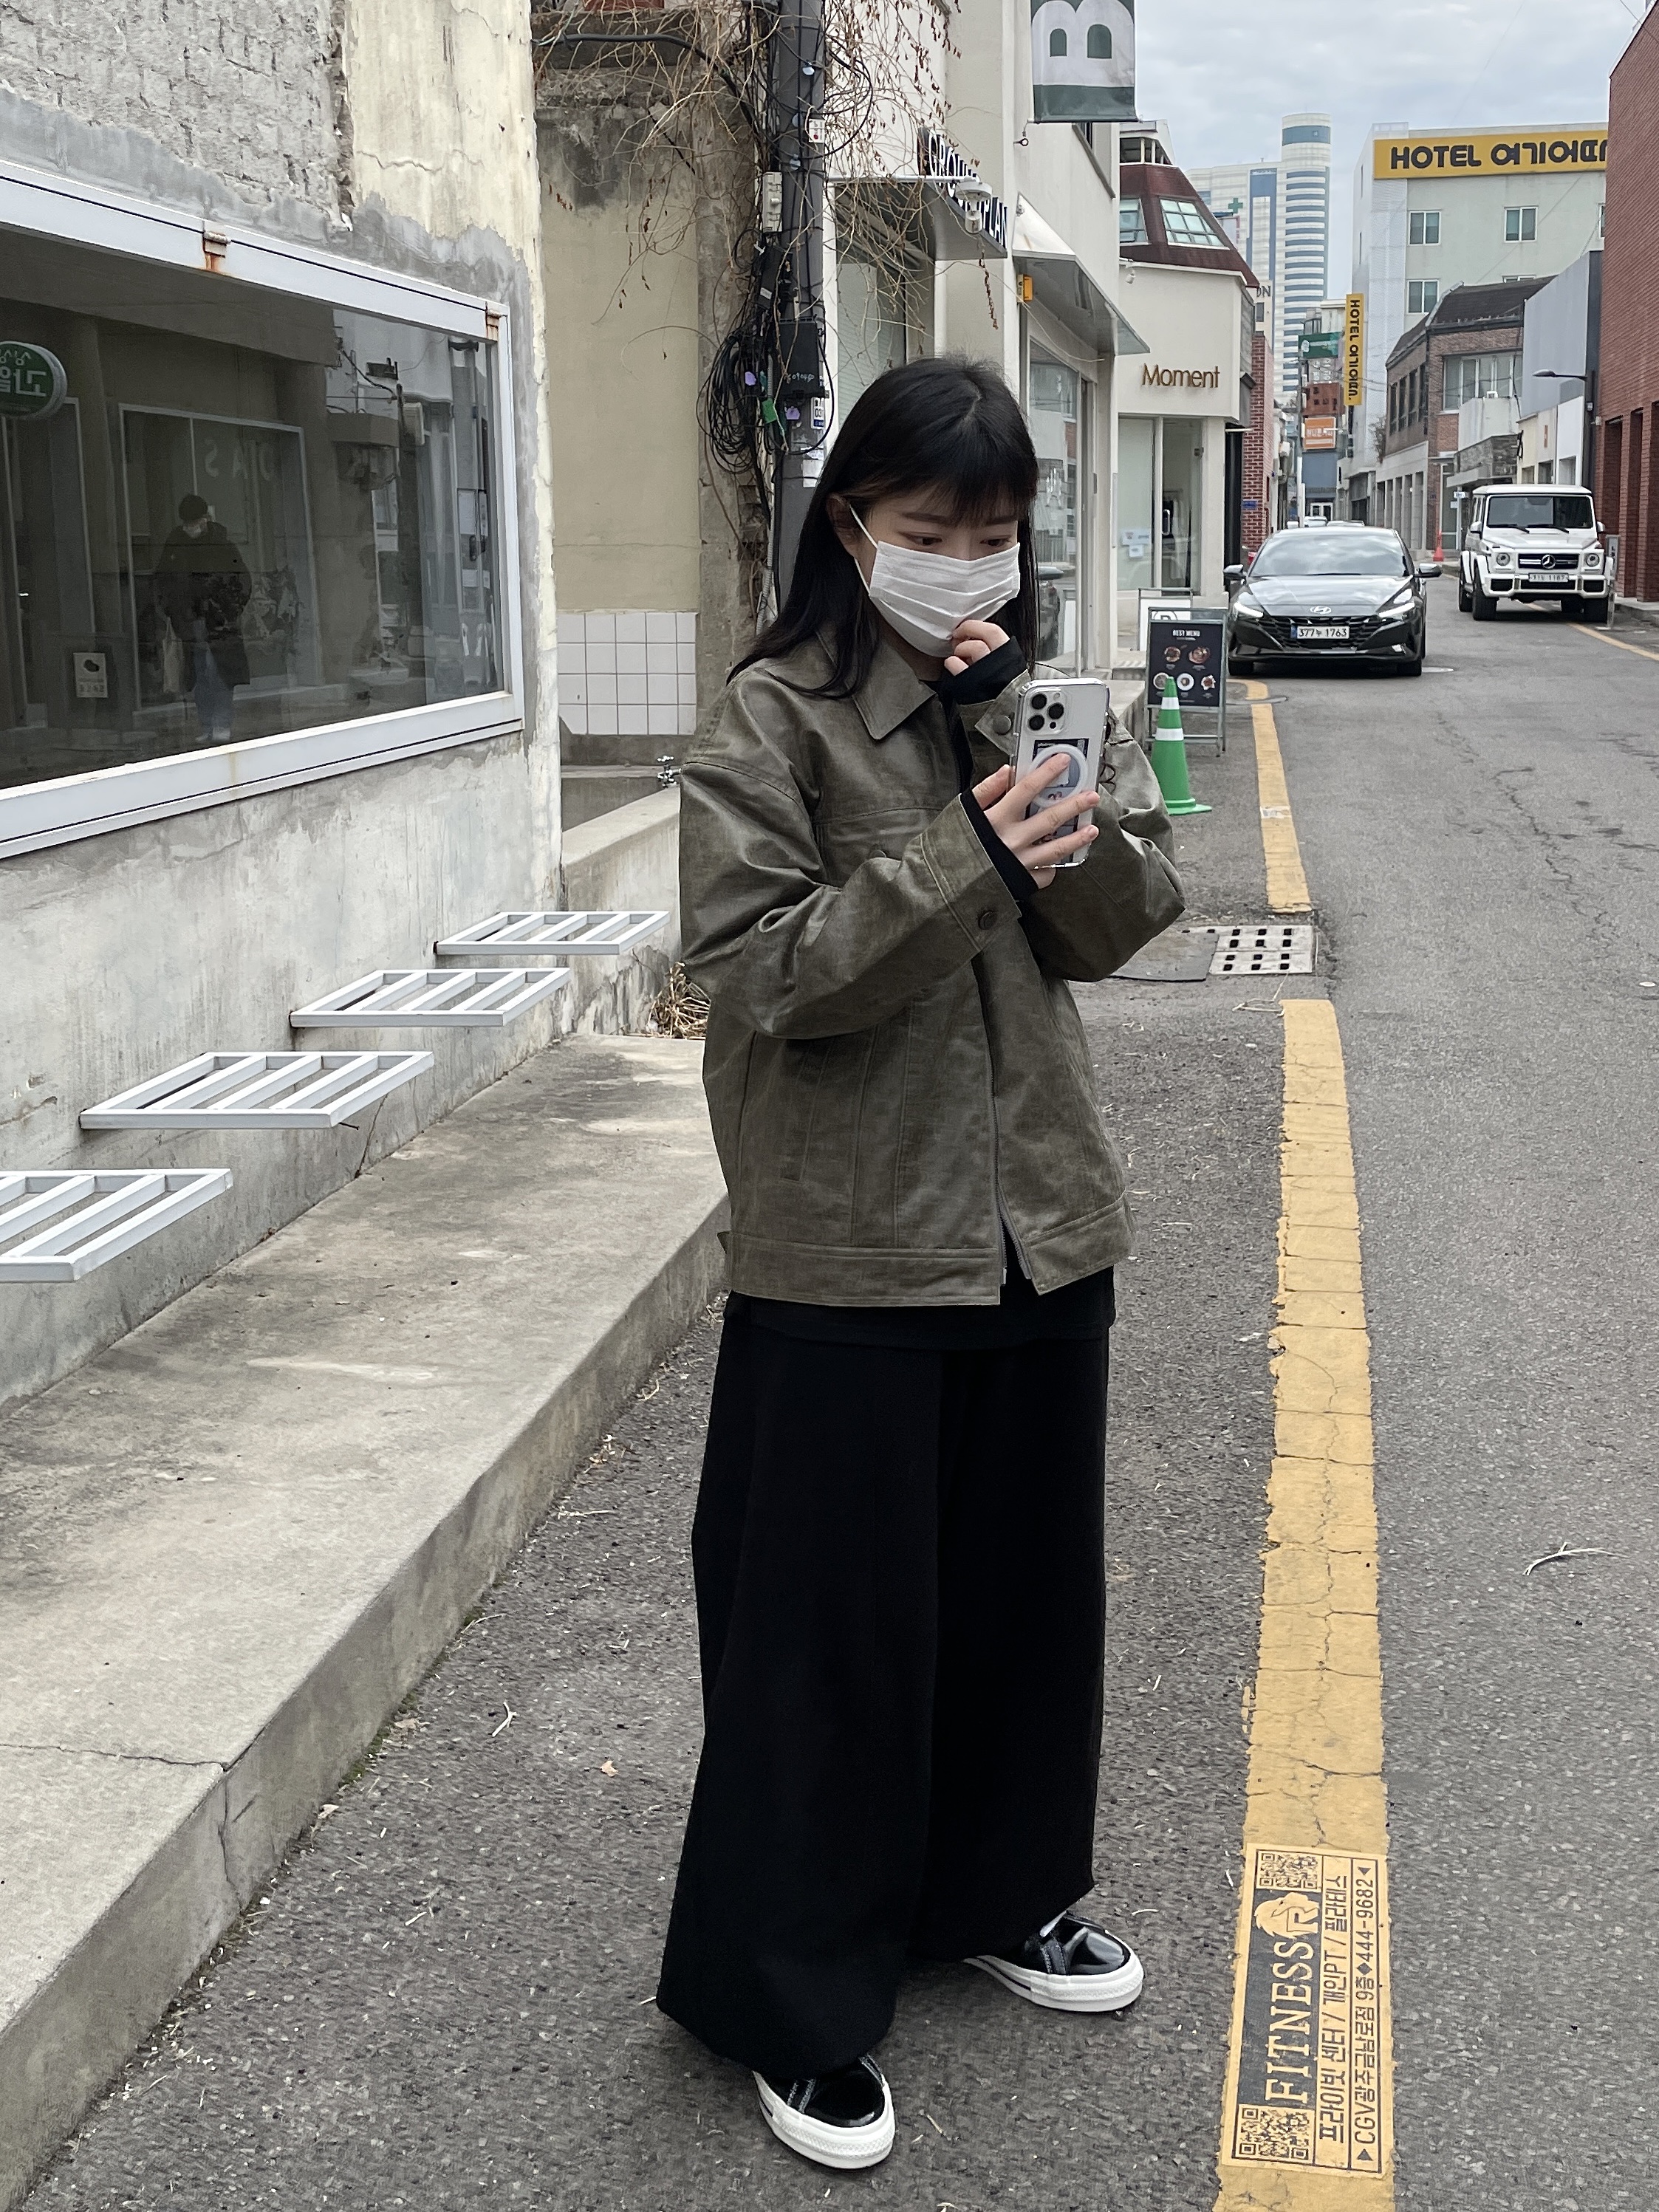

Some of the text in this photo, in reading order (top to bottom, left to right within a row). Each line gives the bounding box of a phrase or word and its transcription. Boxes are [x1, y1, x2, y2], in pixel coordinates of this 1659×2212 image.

[1031, 0, 1135, 87] B
[1390, 144, 1482, 170] HOTEL
[1349, 299, 1361, 341] HOTEL
[1141, 363, 1221, 389] Moment
[1325, 629, 1347, 637] 1763
[1324, 1875, 1347, 1933] 필라테스
[1323, 1950, 1347, 2005] 개인PT
[1265, 1942, 1314, 2104] FITNESS
[1321, 2027, 1346, 2063] 센터
[1354, 2006, 1376, 2145] CGV광주금남로점
[1319, 2068, 1346, 2144] 프라이빗
